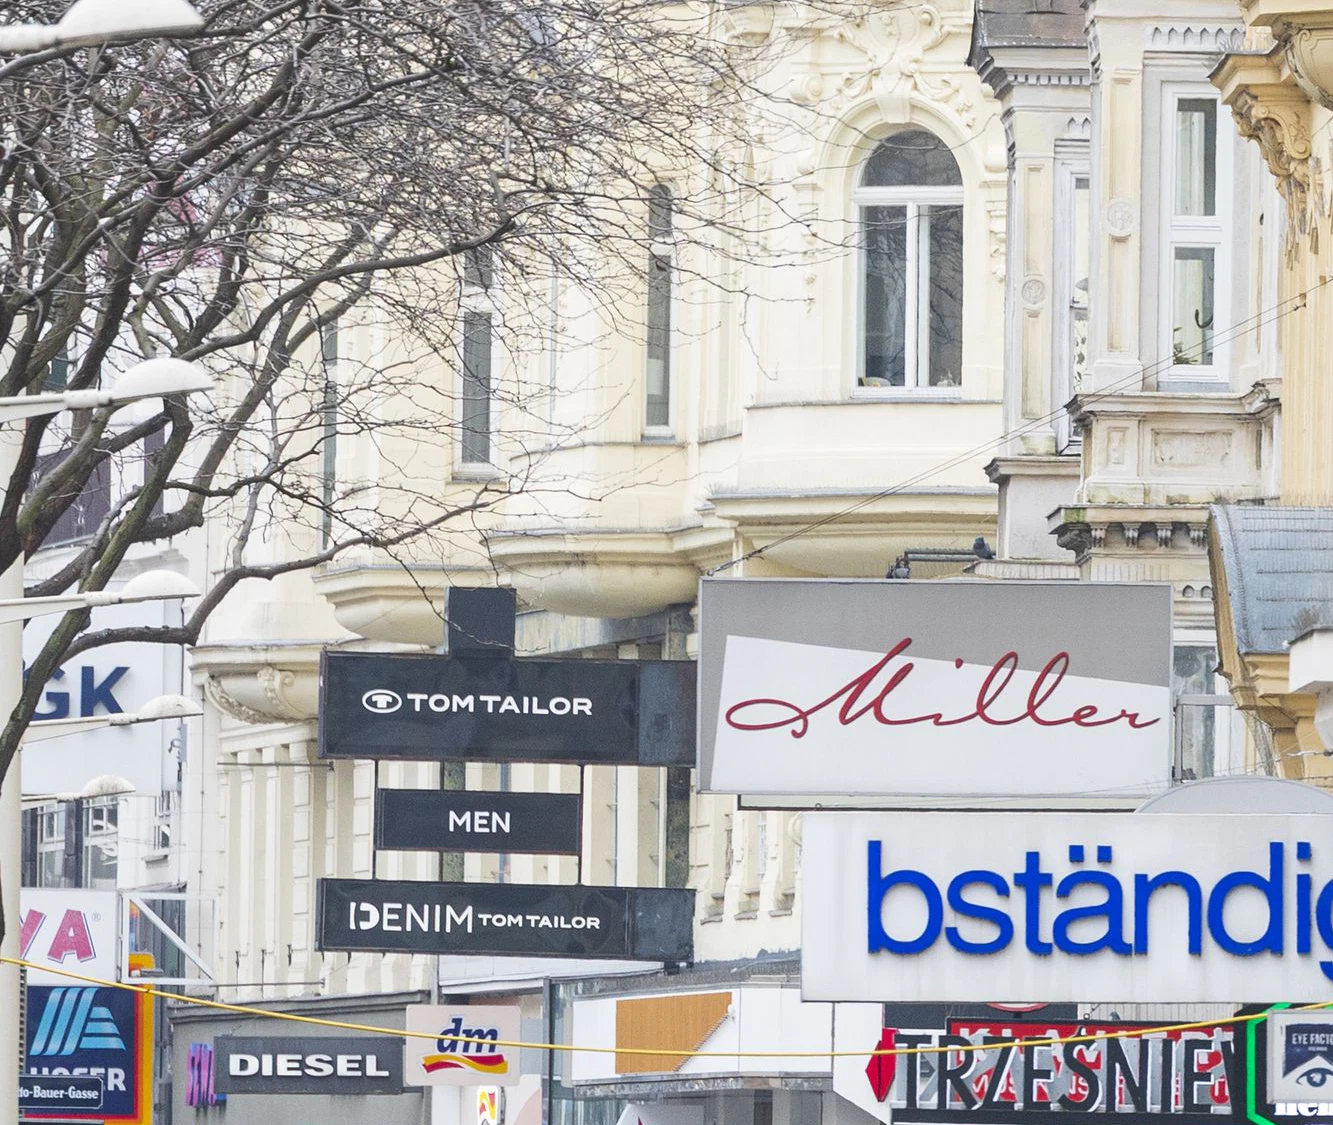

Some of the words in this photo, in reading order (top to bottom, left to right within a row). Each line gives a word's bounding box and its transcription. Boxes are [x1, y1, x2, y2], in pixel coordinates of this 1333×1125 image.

[23, 664, 130, 721] GK
[724, 636, 1162, 739] Miller
[407, 692, 474, 714] TOM
[480, 693, 593, 716] TAILOR
[447, 810, 511, 834] MEN
[349, 902, 473, 933] DENIM
[478, 913, 524, 929] TOM
[526, 914, 601, 930] TAILOR
[437, 1017, 498, 1053] dm
[1292, 1032, 1308, 1046] EYE
[229, 1053, 390, 1078] DIESEL
[893, 1026, 1236, 1114] TRZEŚNIE
